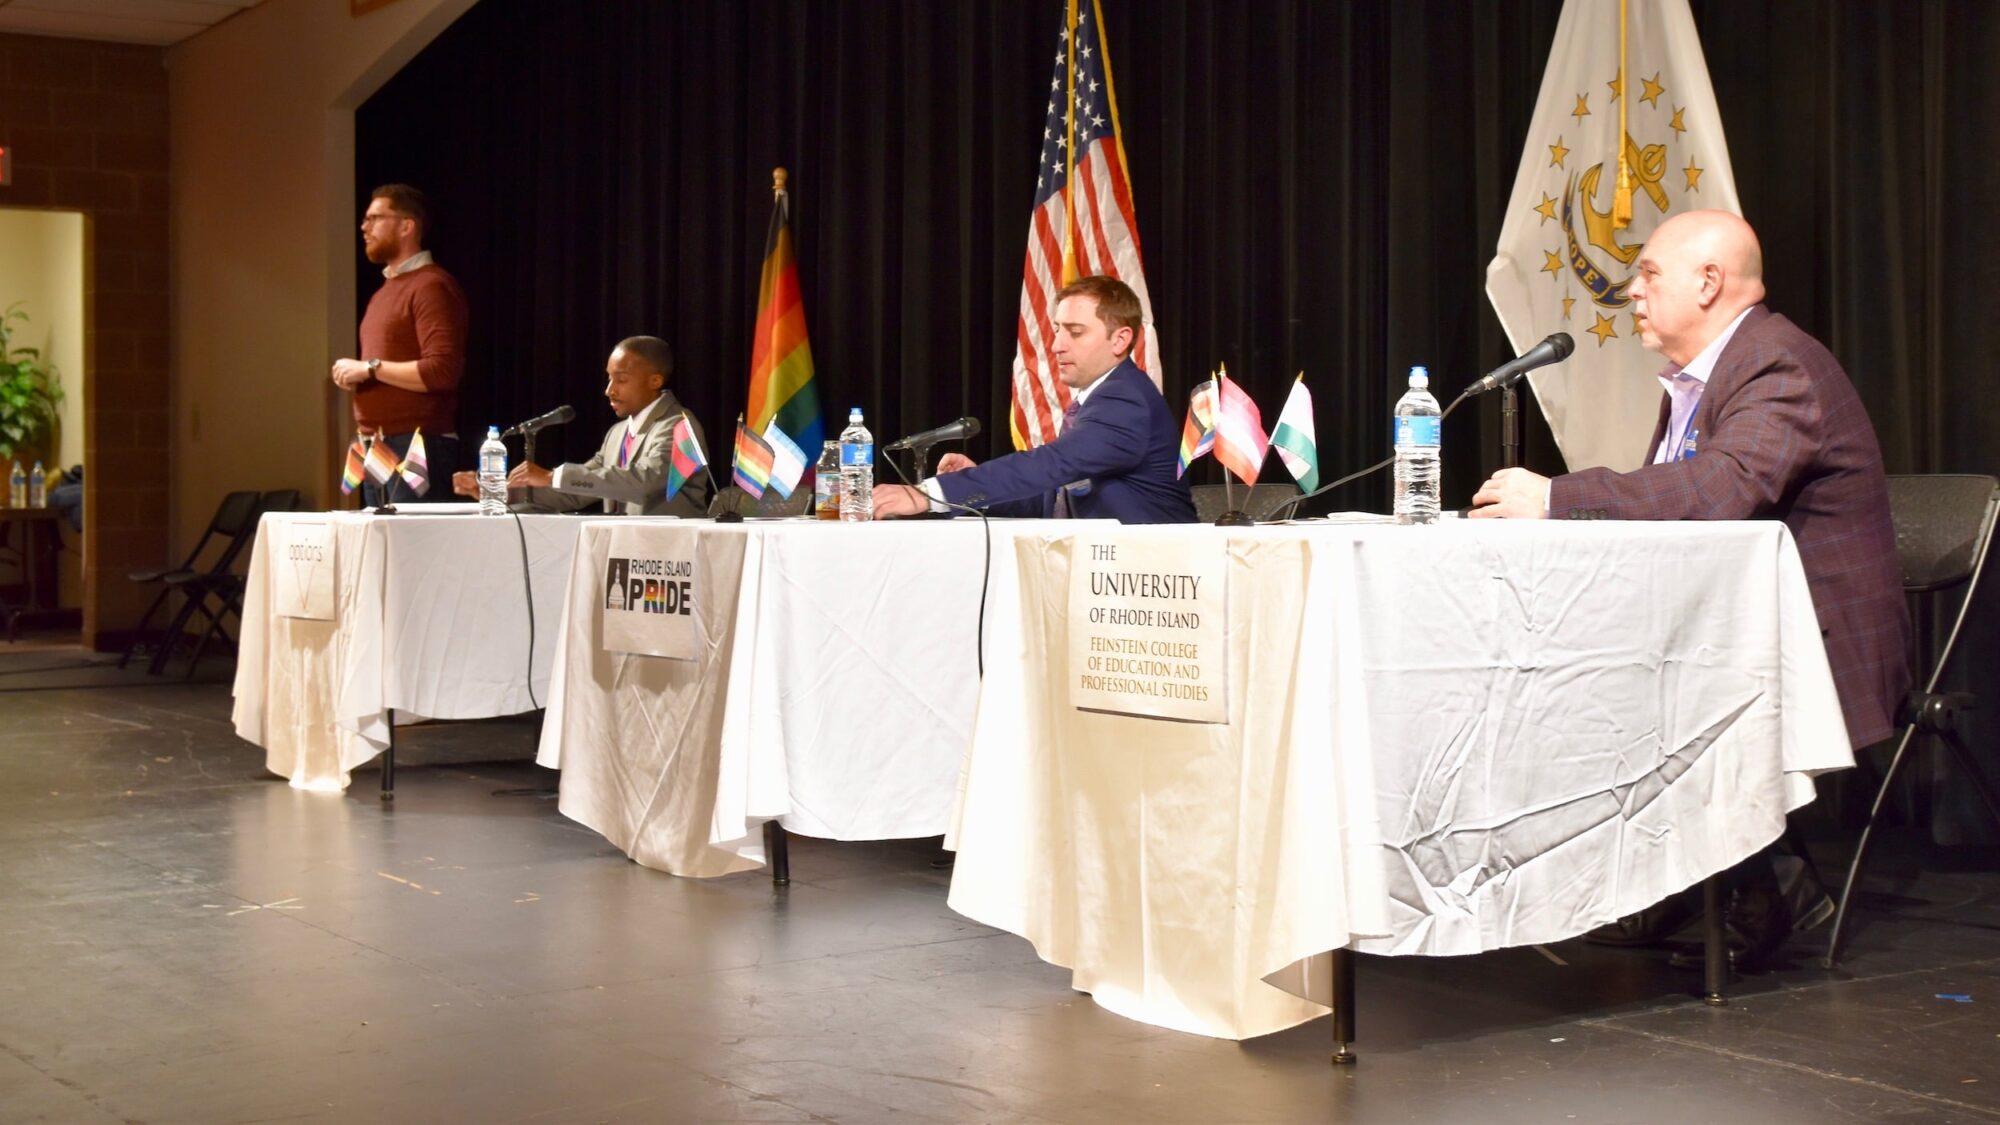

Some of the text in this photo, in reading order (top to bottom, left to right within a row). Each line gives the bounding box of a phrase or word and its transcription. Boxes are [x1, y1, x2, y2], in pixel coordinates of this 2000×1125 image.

[1091, 544, 1117, 561] THE
[631, 559, 692, 577] RHODE ISLAND
[628, 578, 692, 616] PRIDE
[1090, 571, 1202, 600] UNIVERSITY
[1089, 607, 1200, 630] OF RHODE ISLAND
[1090, 636, 1199, 660] FEINSTEIN COLLEGE
[1088, 656, 1200, 680] OF EDUCATION AND
[1081, 674, 1208, 702] PROFESSIONAL STUDIES
